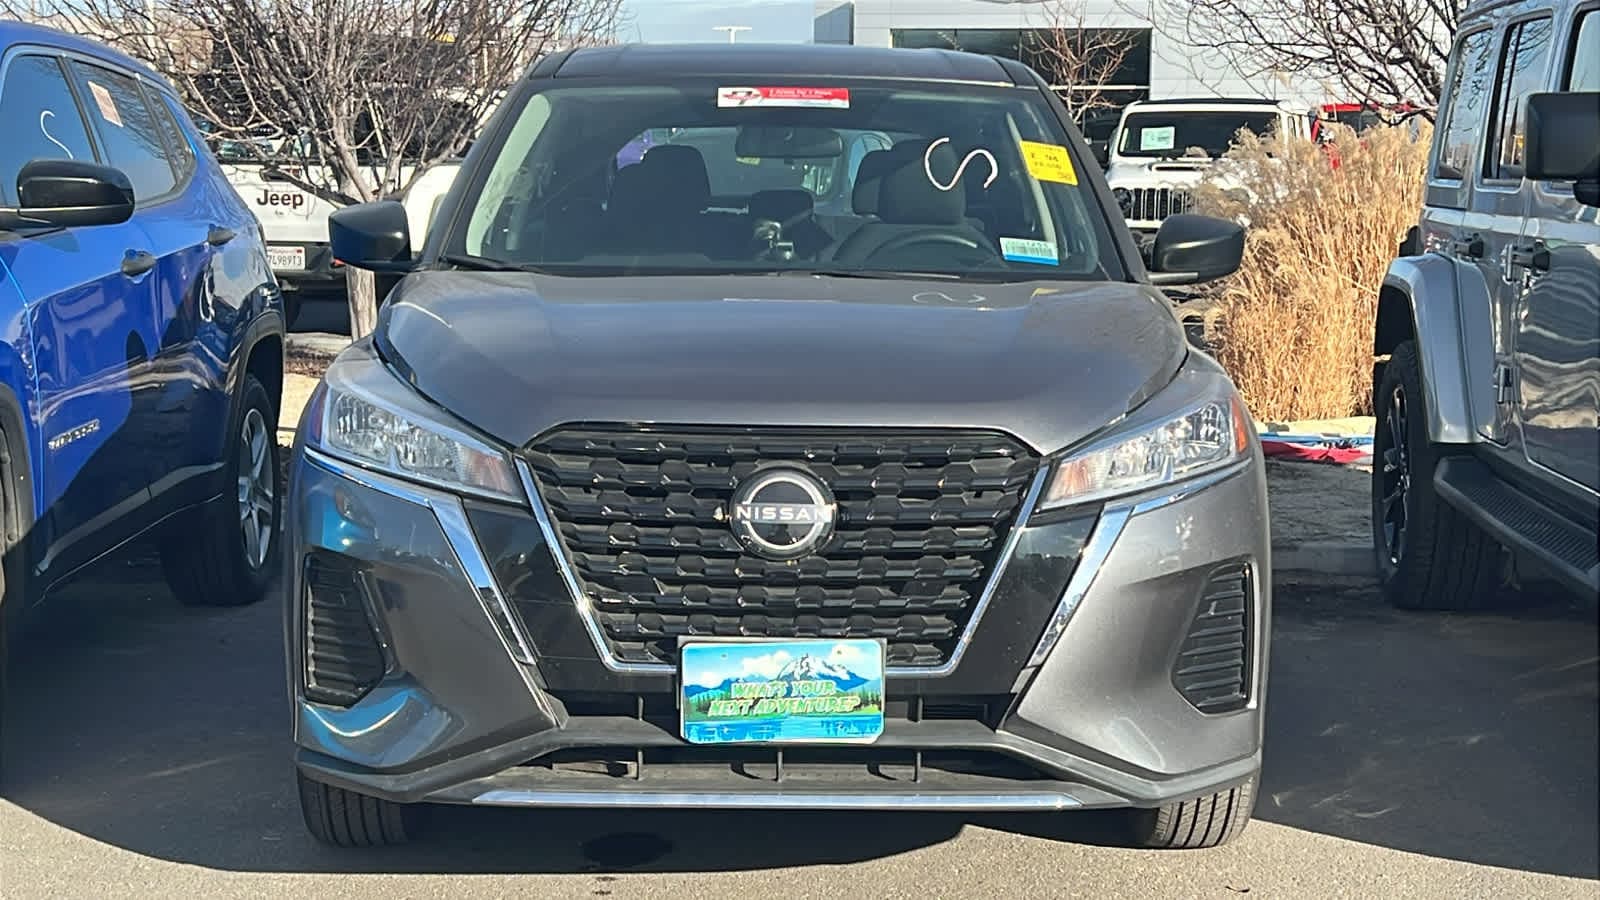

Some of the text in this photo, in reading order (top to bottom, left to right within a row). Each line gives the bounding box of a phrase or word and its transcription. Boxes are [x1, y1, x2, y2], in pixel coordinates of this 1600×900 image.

[256, 189, 305, 209] Jeep
[736, 505, 832, 521] NISSAN
[791, 680, 836, 696] YOUR
[708, 696, 861, 716] NEXT ADVENTURE?
